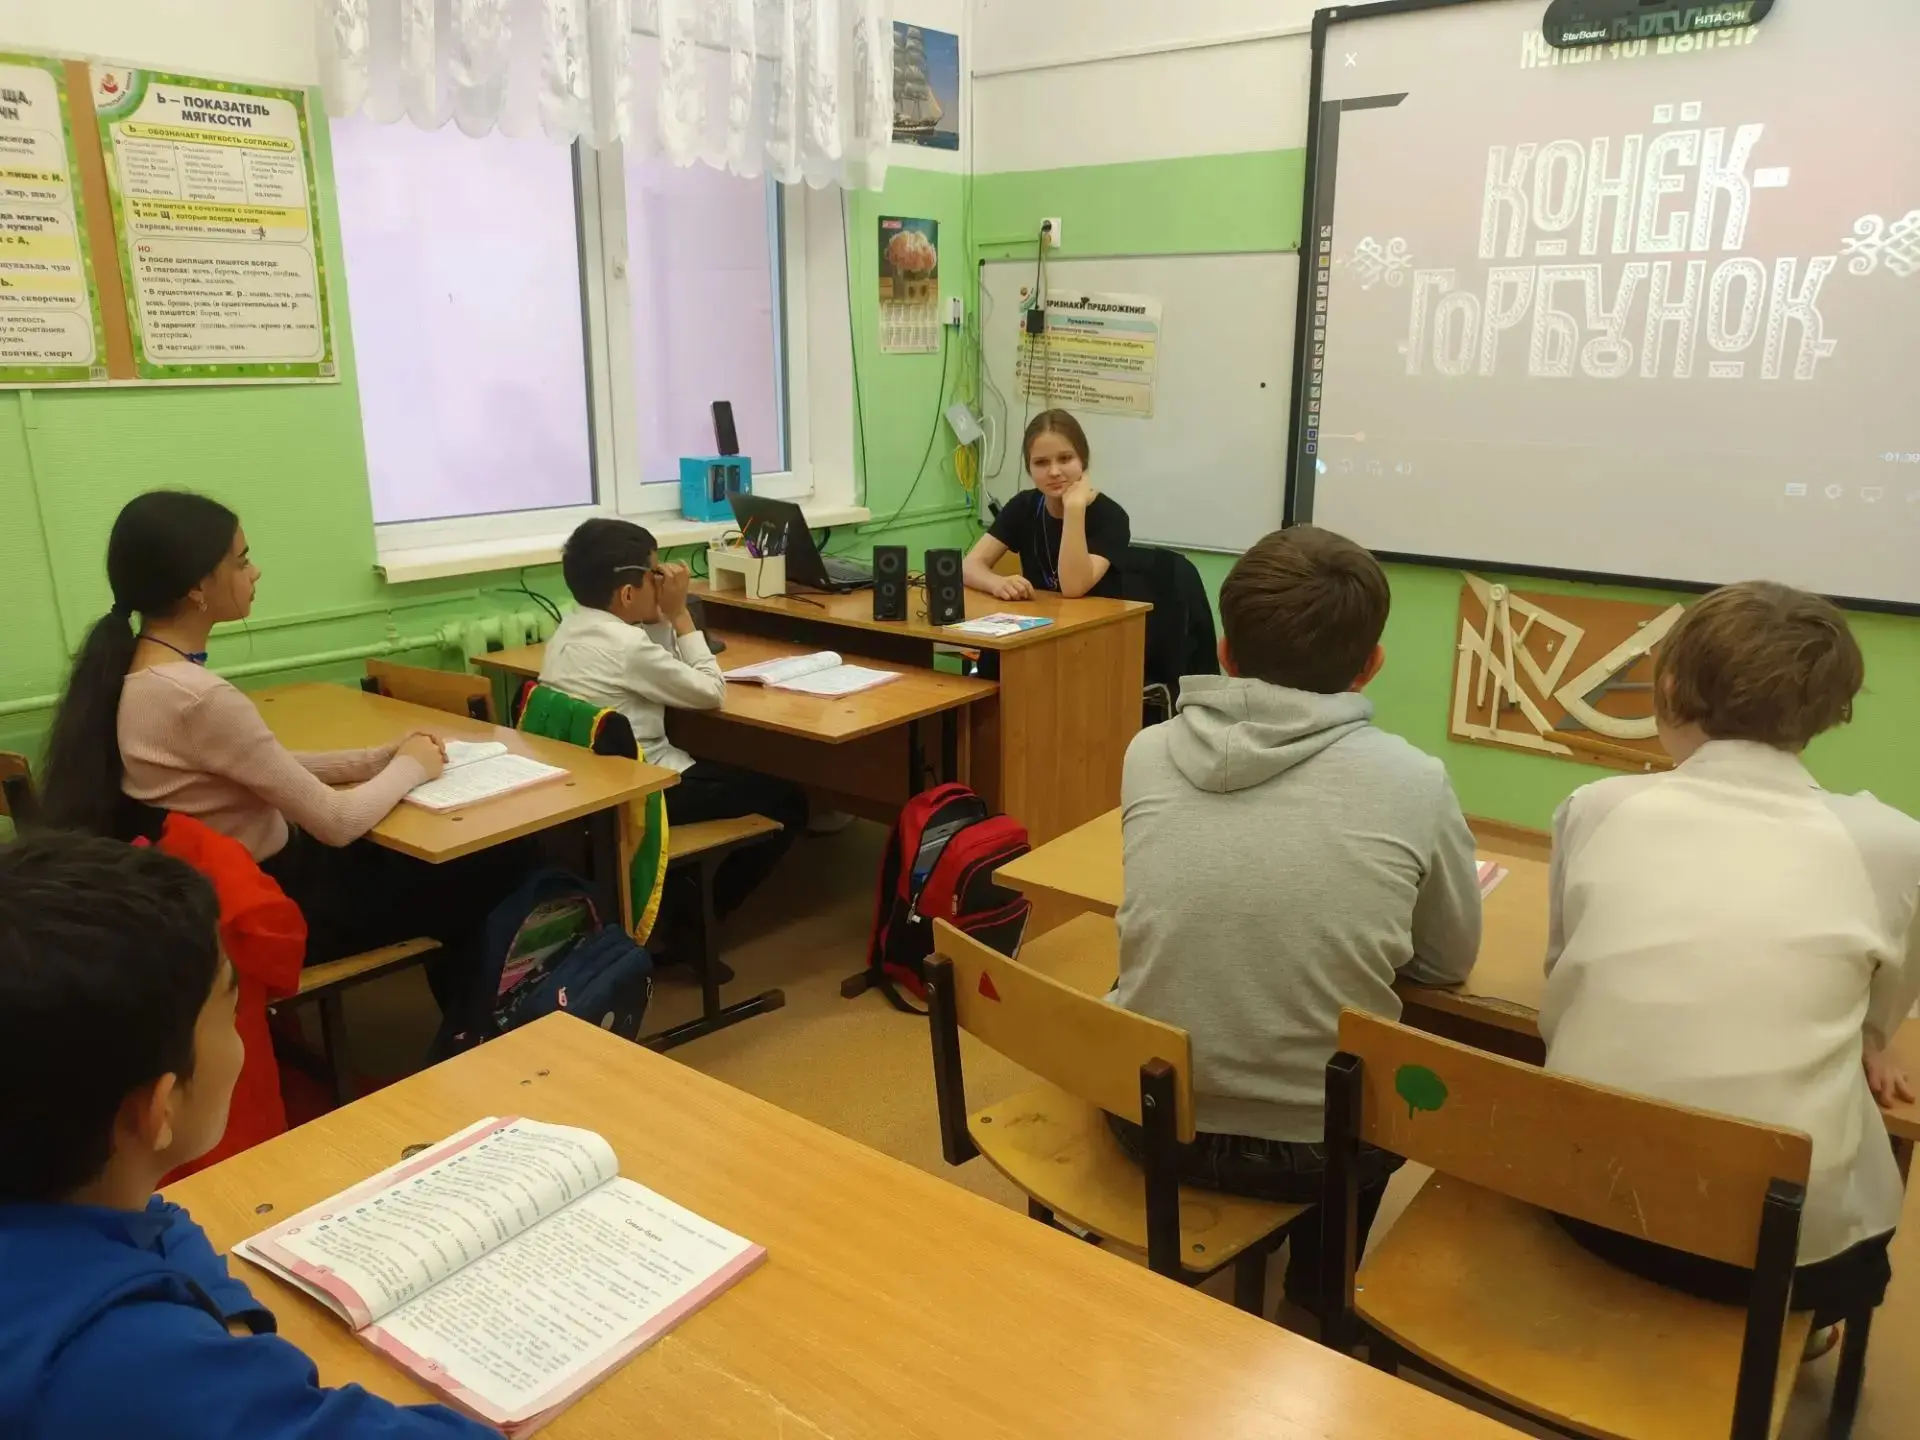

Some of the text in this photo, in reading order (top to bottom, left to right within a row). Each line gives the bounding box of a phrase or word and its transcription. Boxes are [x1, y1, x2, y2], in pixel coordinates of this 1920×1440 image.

[1694, 11, 1745, 25] HITACHI
[1562, 29, 1606, 42] StarBoard
[183, 95, 270, 116] ПОКАЗАТЕЛЬ
[181, 110, 252, 128] МЯГКОСТИ
[148, 128, 200, 140] ОБОЗНАЧАЕТ
[202, 133, 242, 144] МЯГКОСТЬ
[1478, 101, 1791, 259] КОНЁК-
[153, 203, 186, 211] пишется
[148, 256, 173, 264] после
[215, 259, 249, 267] пишется
[1087, 303, 1146, 315] ПРЕДЛОЖЕНИЯ
[1398, 255, 1838, 380] ГОРБУНОК
